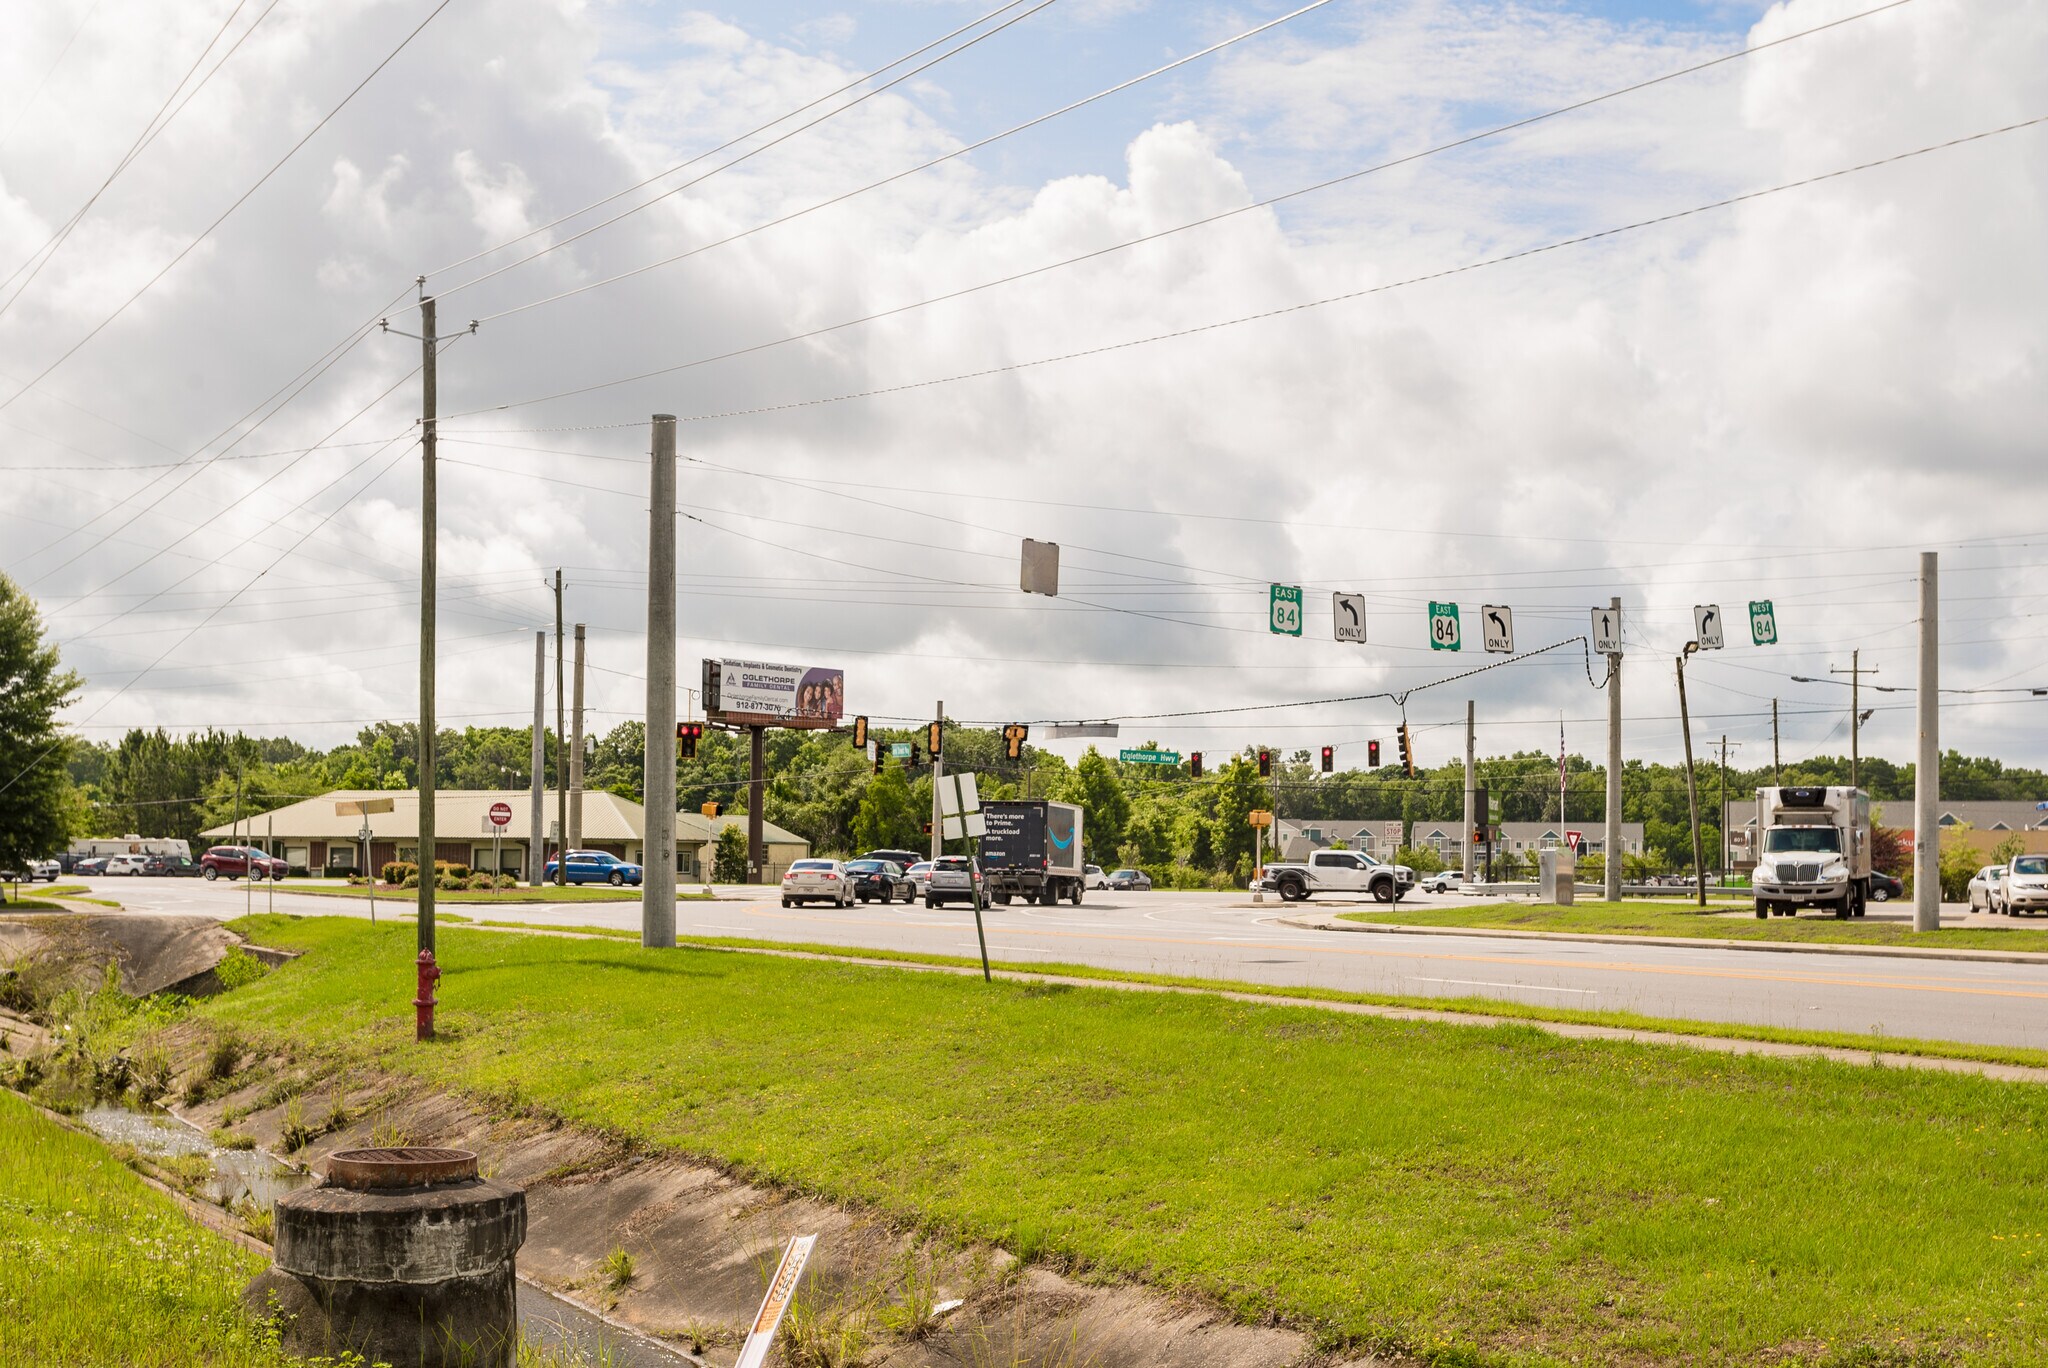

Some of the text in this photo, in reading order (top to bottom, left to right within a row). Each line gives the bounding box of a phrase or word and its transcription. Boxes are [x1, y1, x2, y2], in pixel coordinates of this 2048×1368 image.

[1275, 588, 1298, 599] EAST
[1436, 605, 1451, 614] EAST
[1752, 603, 1770, 613] WEST
[1277, 607, 1295, 626] 84
[1339, 627, 1361, 637] ONLY
[1436, 619, 1453, 641] 84
[1756, 620, 1771, 636] 84
[1488, 639, 1509, 648] ONLY
[1599, 640, 1616, 649] ONLY
[1701, 636, 1719, 645] ONLY
[743, 661, 761, 670] Implants
[766, 663, 784, 672] Cosmetic
[784, 665, 802, 674] Dentistry
[742, 674, 795, 684] OGLETHORPE
[1122, 751, 1175, 763] Oglethorpe Hwy
